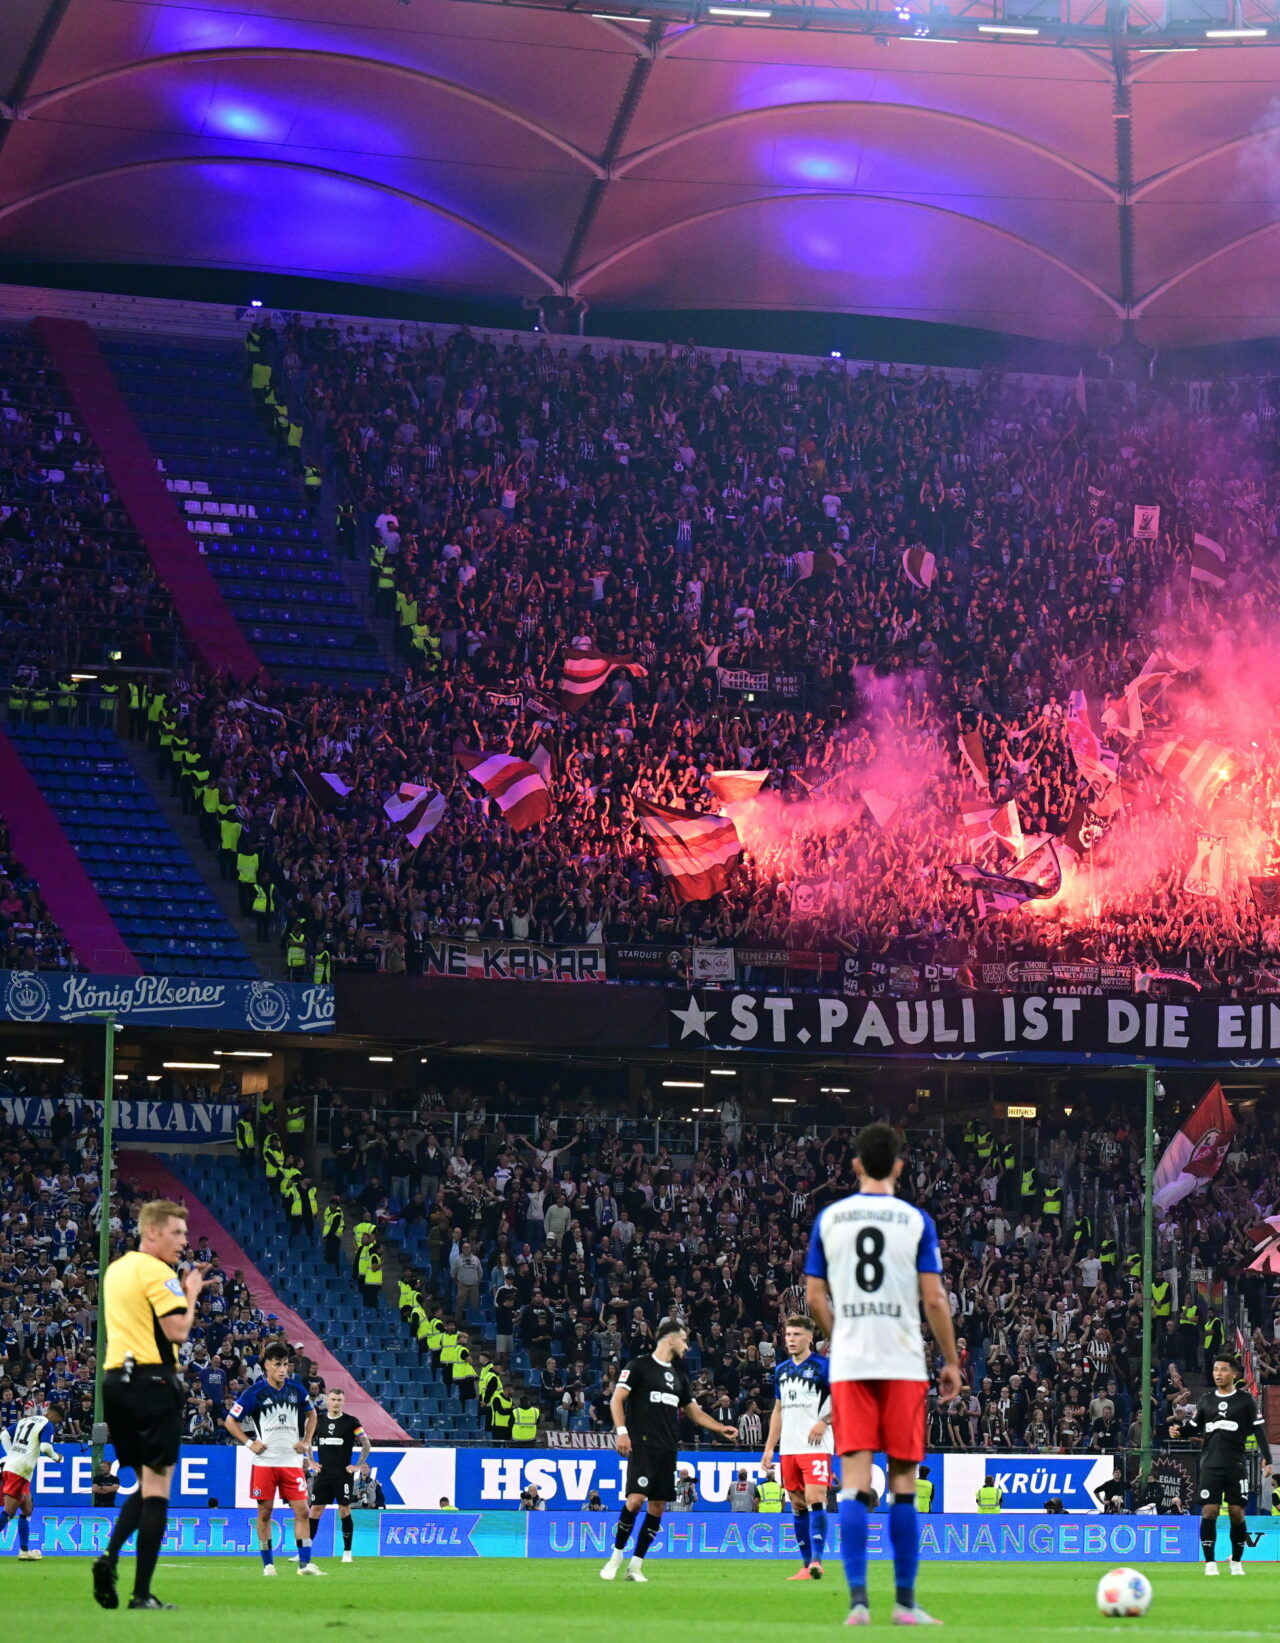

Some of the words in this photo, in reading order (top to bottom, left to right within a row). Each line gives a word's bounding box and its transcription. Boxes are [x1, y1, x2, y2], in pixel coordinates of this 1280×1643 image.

[618, 950, 663, 959] STARDUST
[1023, 961, 1048, 969] AMORE
[1101, 968, 1132, 977] BRUTTE
[1023, 974, 1048, 983] ETERNO
[58, 973, 133, 1013] König
[133, 975, 225, 1006] Pilsener
[1002, 993, 1081, 1044] IST
[1107, 999, 1190, 1048] DIE
[855, 1226, 885, 1293] 8
[16, 1422, 36, 1446] 11
[811, 1459, 829, 1476] 21
[343, 1483, 350, 1495] 8
[993, 1467, 1077, 1496] KRÜLL
[1158, 1475, 1182, 1486] EGALE
[385, 1521, 462, 1545] KRÜLL
[549, 1520, 883, 1553] UNSCHLAGBE
